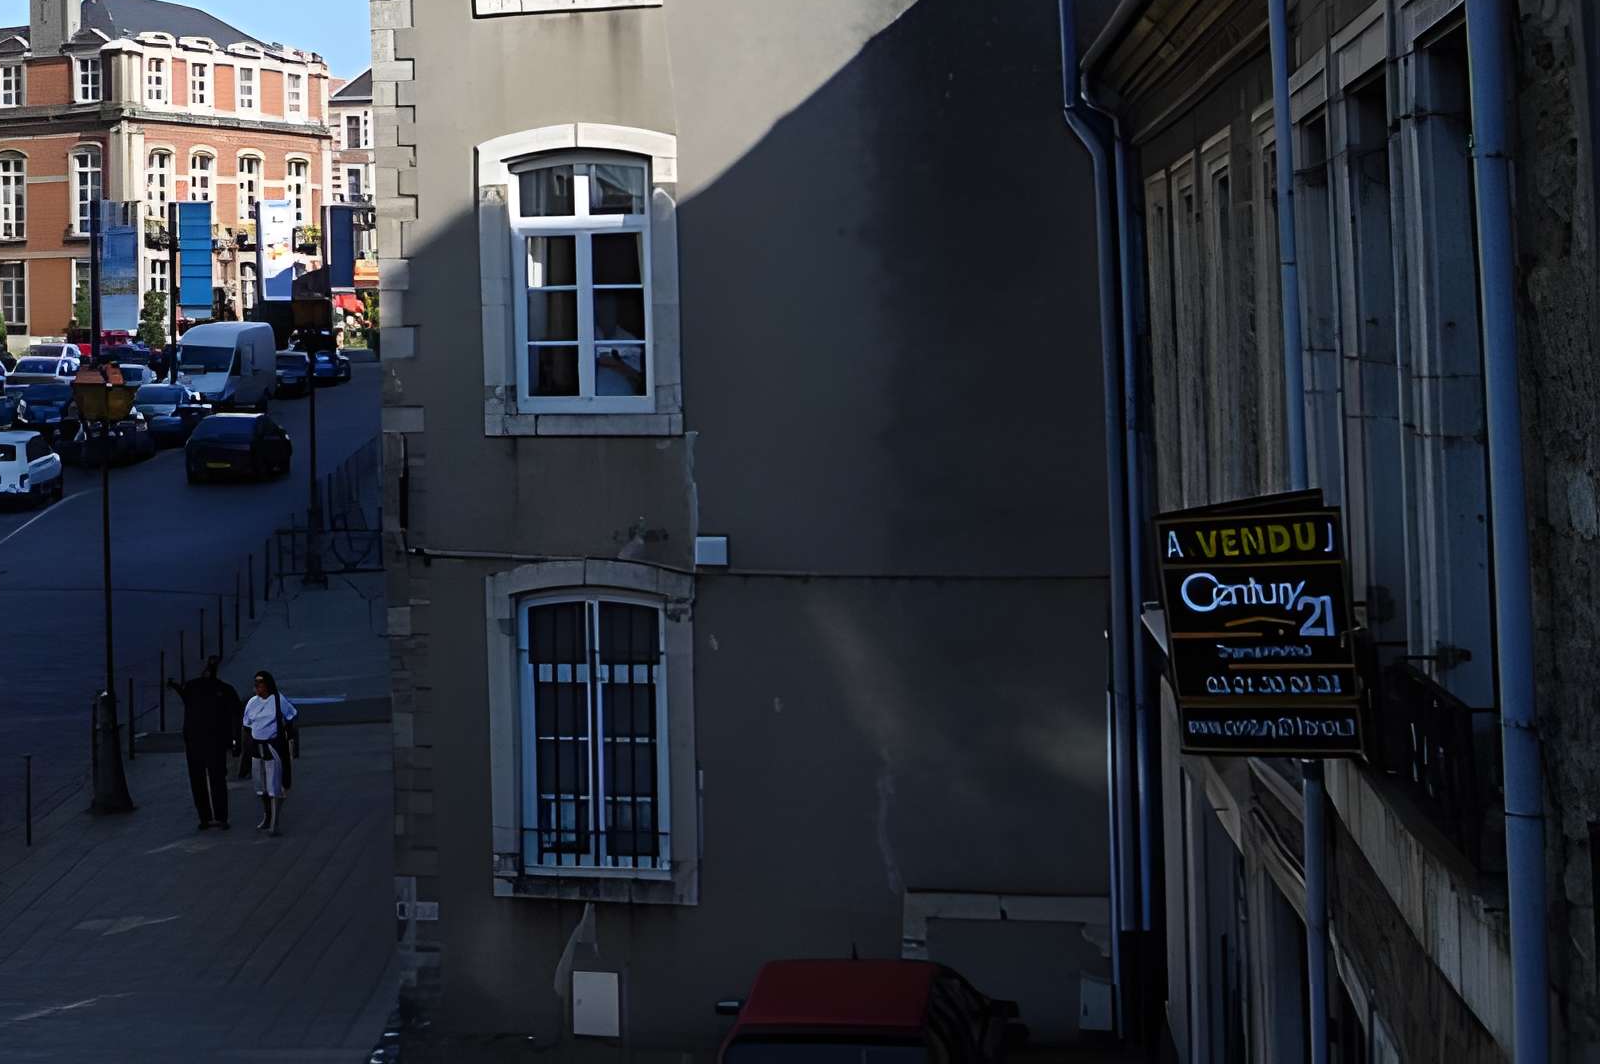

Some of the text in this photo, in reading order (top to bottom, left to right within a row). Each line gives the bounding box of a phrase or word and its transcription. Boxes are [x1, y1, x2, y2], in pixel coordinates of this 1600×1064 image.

[1167, 529, 1184, 558] A
[1195, 521, 1317, 558] VENDU
[1180, 571, 1337, 638] Century 21
